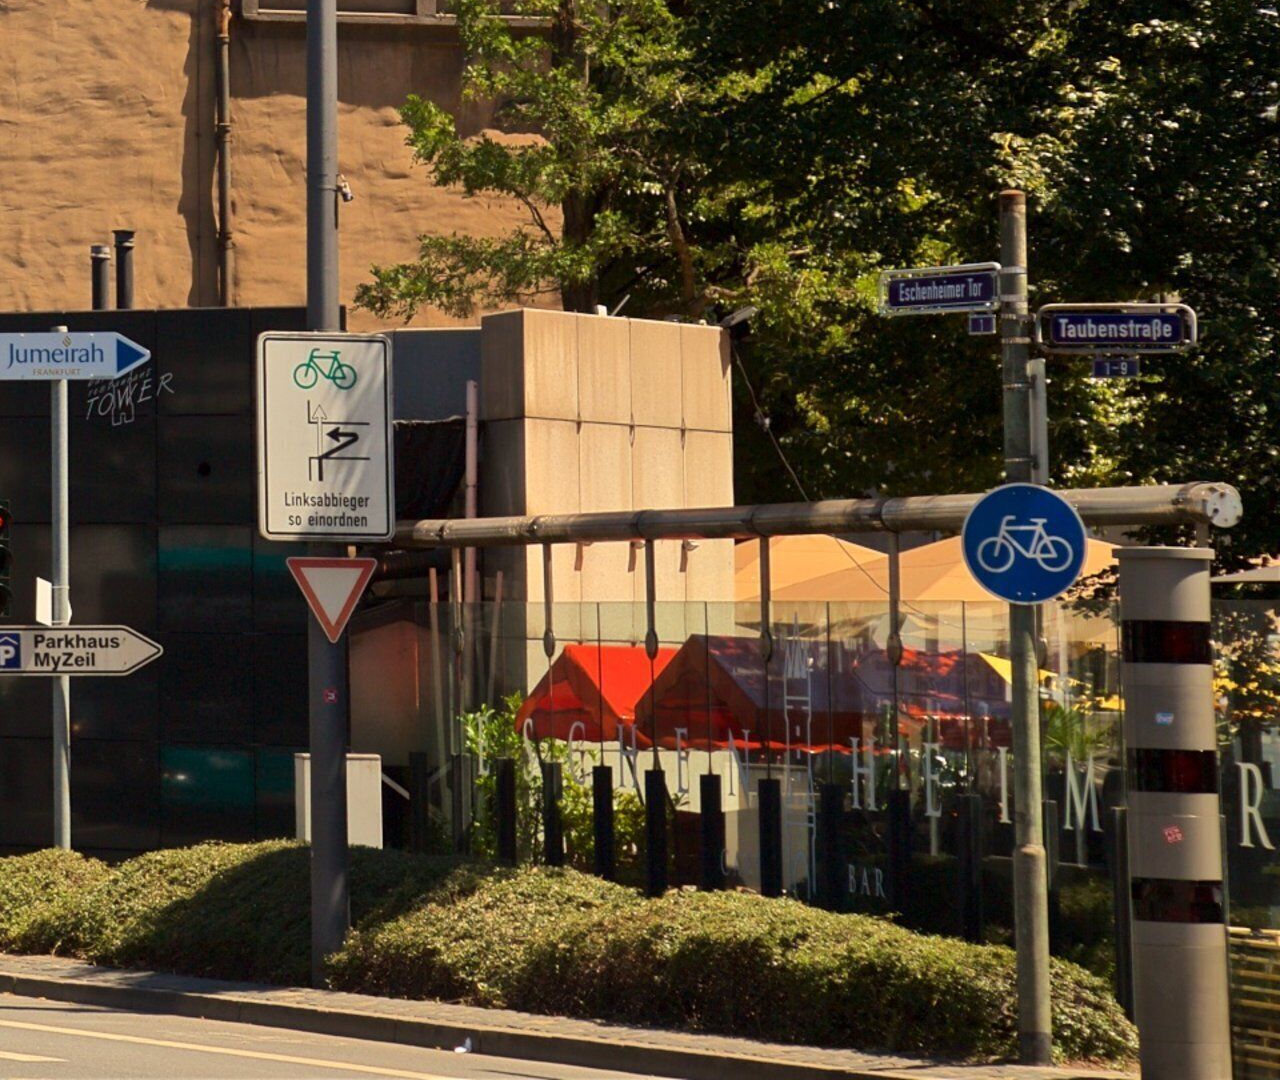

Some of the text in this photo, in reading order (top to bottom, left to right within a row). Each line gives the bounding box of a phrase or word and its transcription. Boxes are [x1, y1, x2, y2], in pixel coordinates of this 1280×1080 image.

[899, 278, 983, 302] Eschenheimer Tor
[1059, 318, 1173, 341] Taubenstraße
[7, 342, 104, 369] Jumeirah
[32, 368, 81, 376] FRANKFURT
[86, 372, 175, 420] TOWER
[285, 492, 370, 511] Linksabbieger
[289, 512, 368, 527] so einordnen
[34, 634, 120, 649] Parkhaus
[34, 653, 96, 670] MyZeil
[847, 863, 886, 898] BAR
